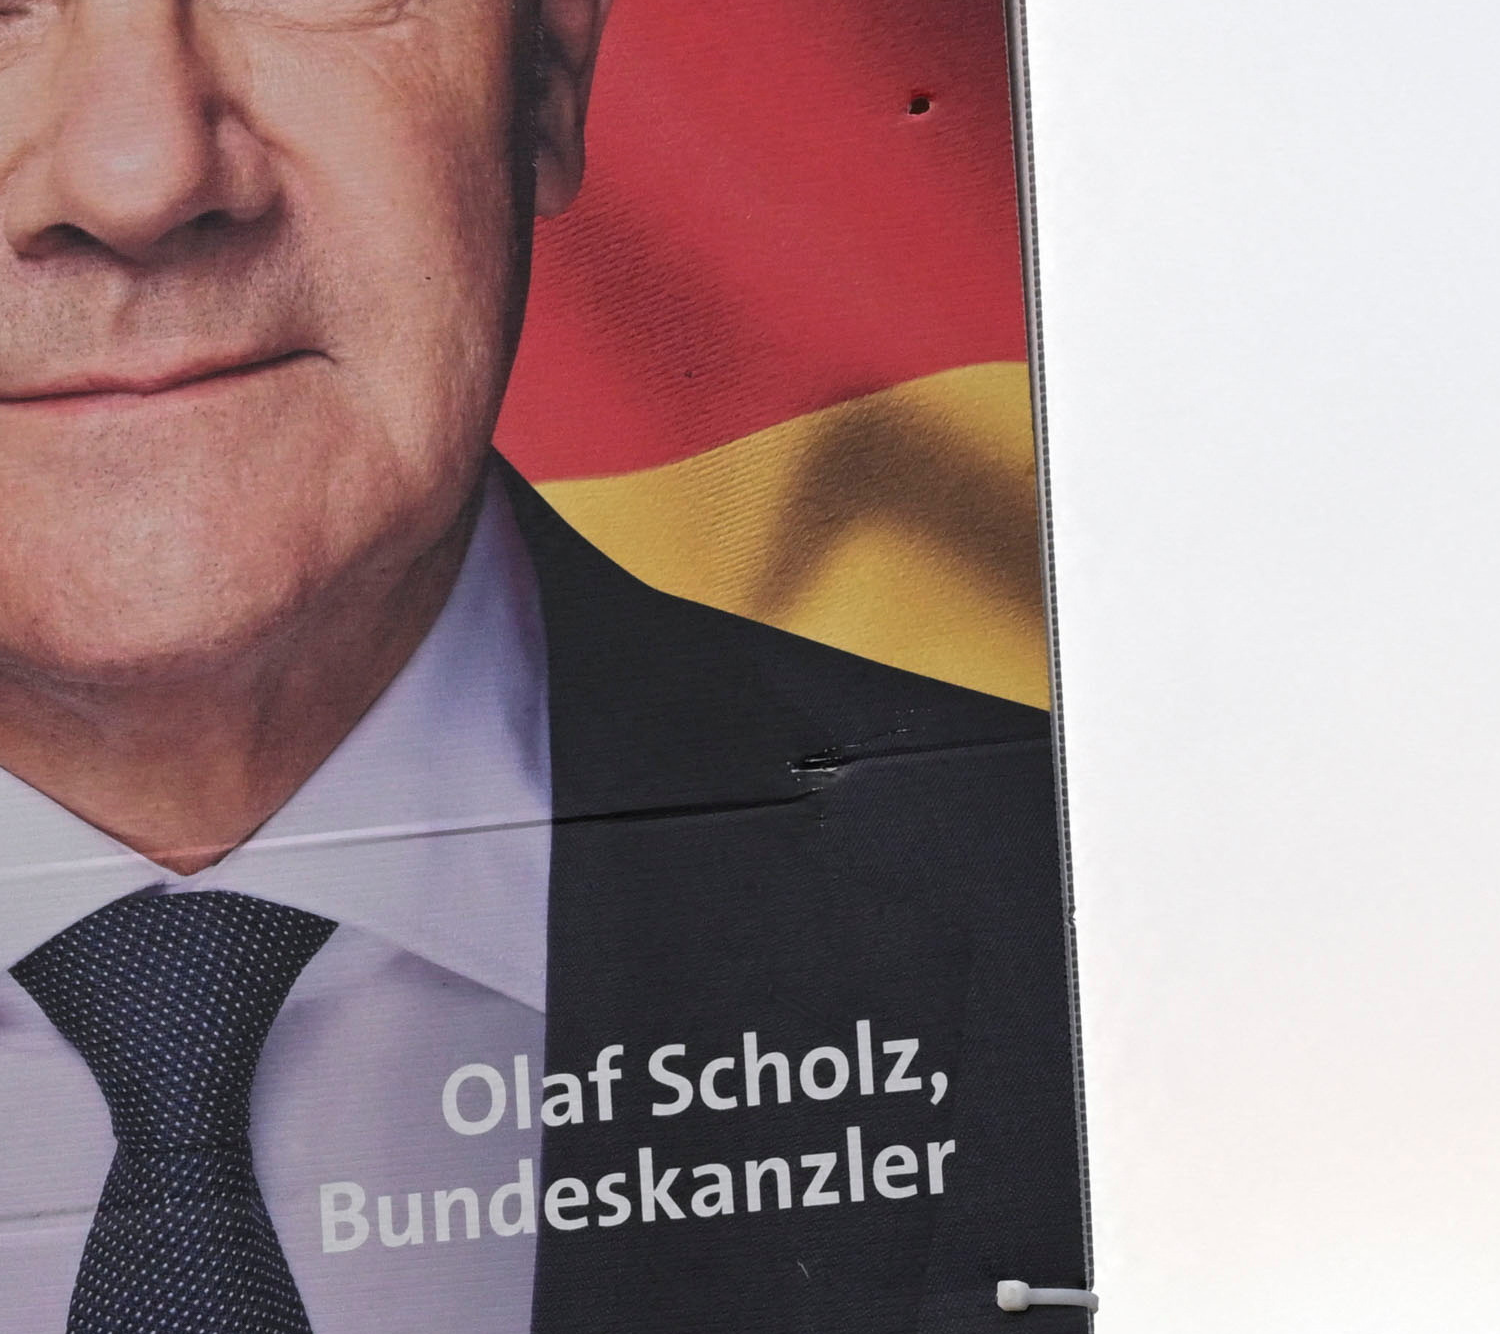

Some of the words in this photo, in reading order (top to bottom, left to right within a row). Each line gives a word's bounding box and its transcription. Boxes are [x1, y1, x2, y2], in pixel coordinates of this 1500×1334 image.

[442, 1044, 624, 1135] Olaf
[648, 1019, 948, 1117] Scholz,
[319, 1127, 956, 1253] Bundeskanzler
